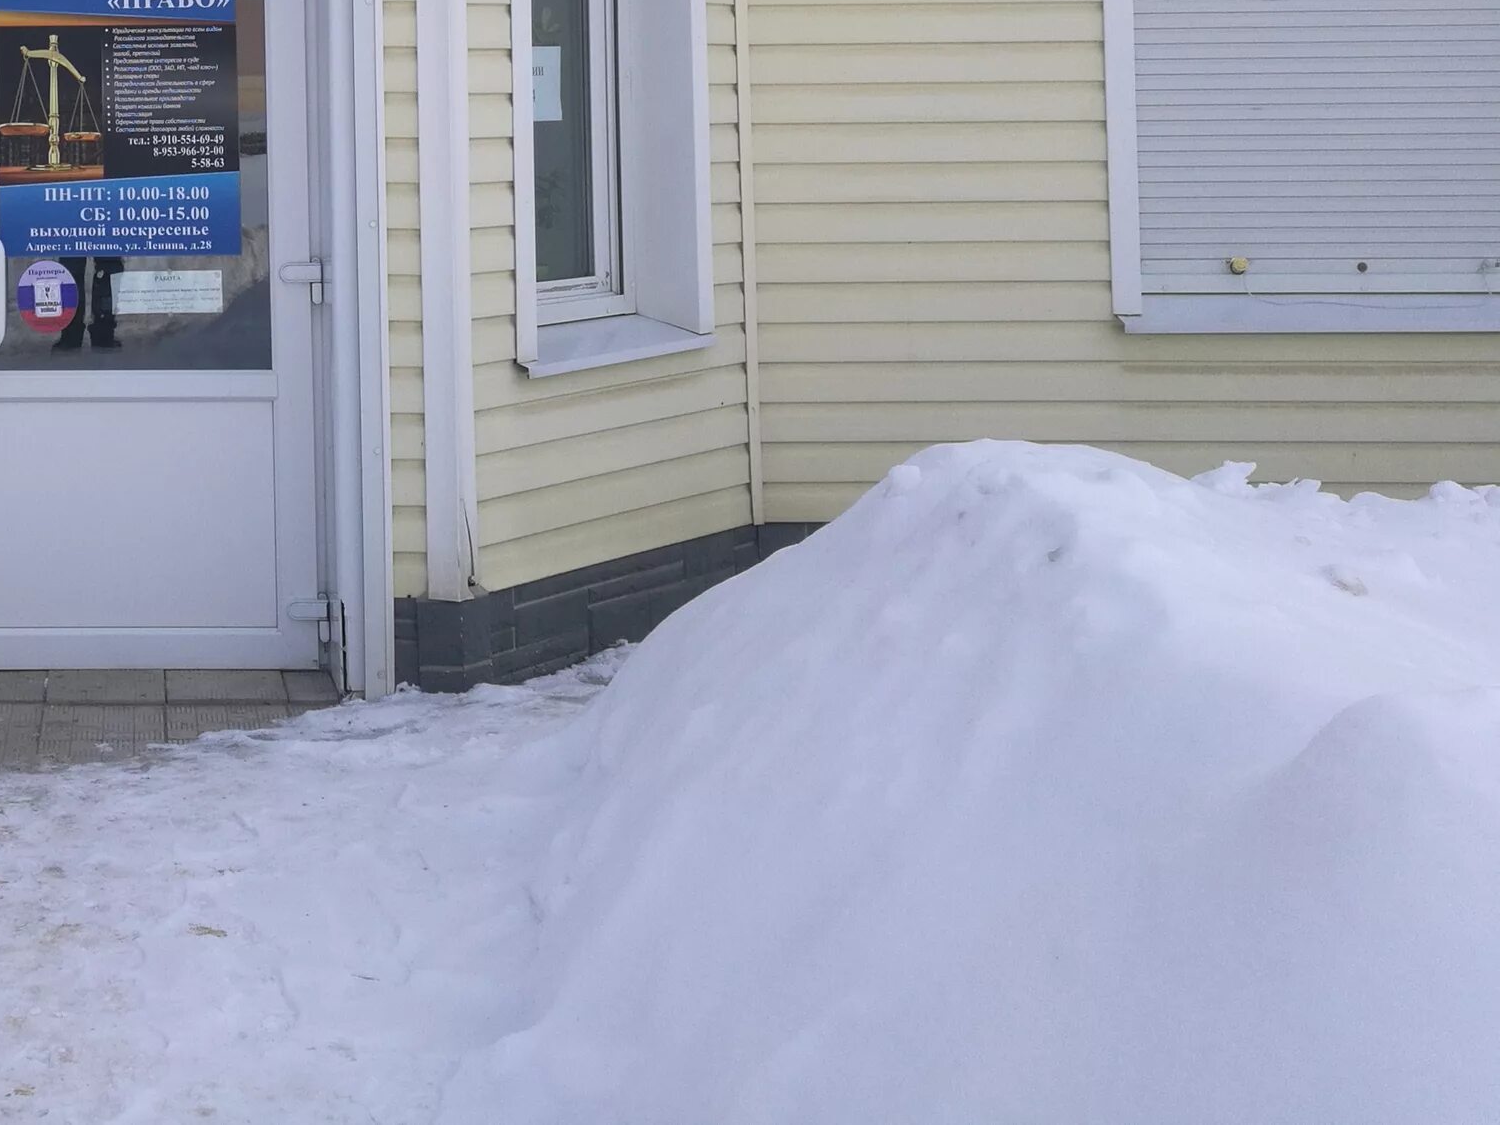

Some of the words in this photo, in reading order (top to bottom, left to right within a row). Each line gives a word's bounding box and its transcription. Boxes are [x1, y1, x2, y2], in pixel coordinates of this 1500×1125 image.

[128, 136, 150, 146] тел.:
[152, 134, 225, 146] 8-910-554-69-49
[153, 146, 225, 157] 8-953-966-92-00
[191, 158, 225, 168] 5-58-63
[45, 187, 112, 202] ПН-ПТ:
[118, 186, 210, 201] 10.00-18.00
[80, 207, 112, 222] СБ:
[118, 206, 210, 221] 10.00-15.00
[30, 224, 107, 239] выходной
[112, 225, 209, 239] воскресенье
[25, 242, 61, 253] Адрес:
[125, 243, 141, 253] ул.
[190, 241, 212, 251] д.28
